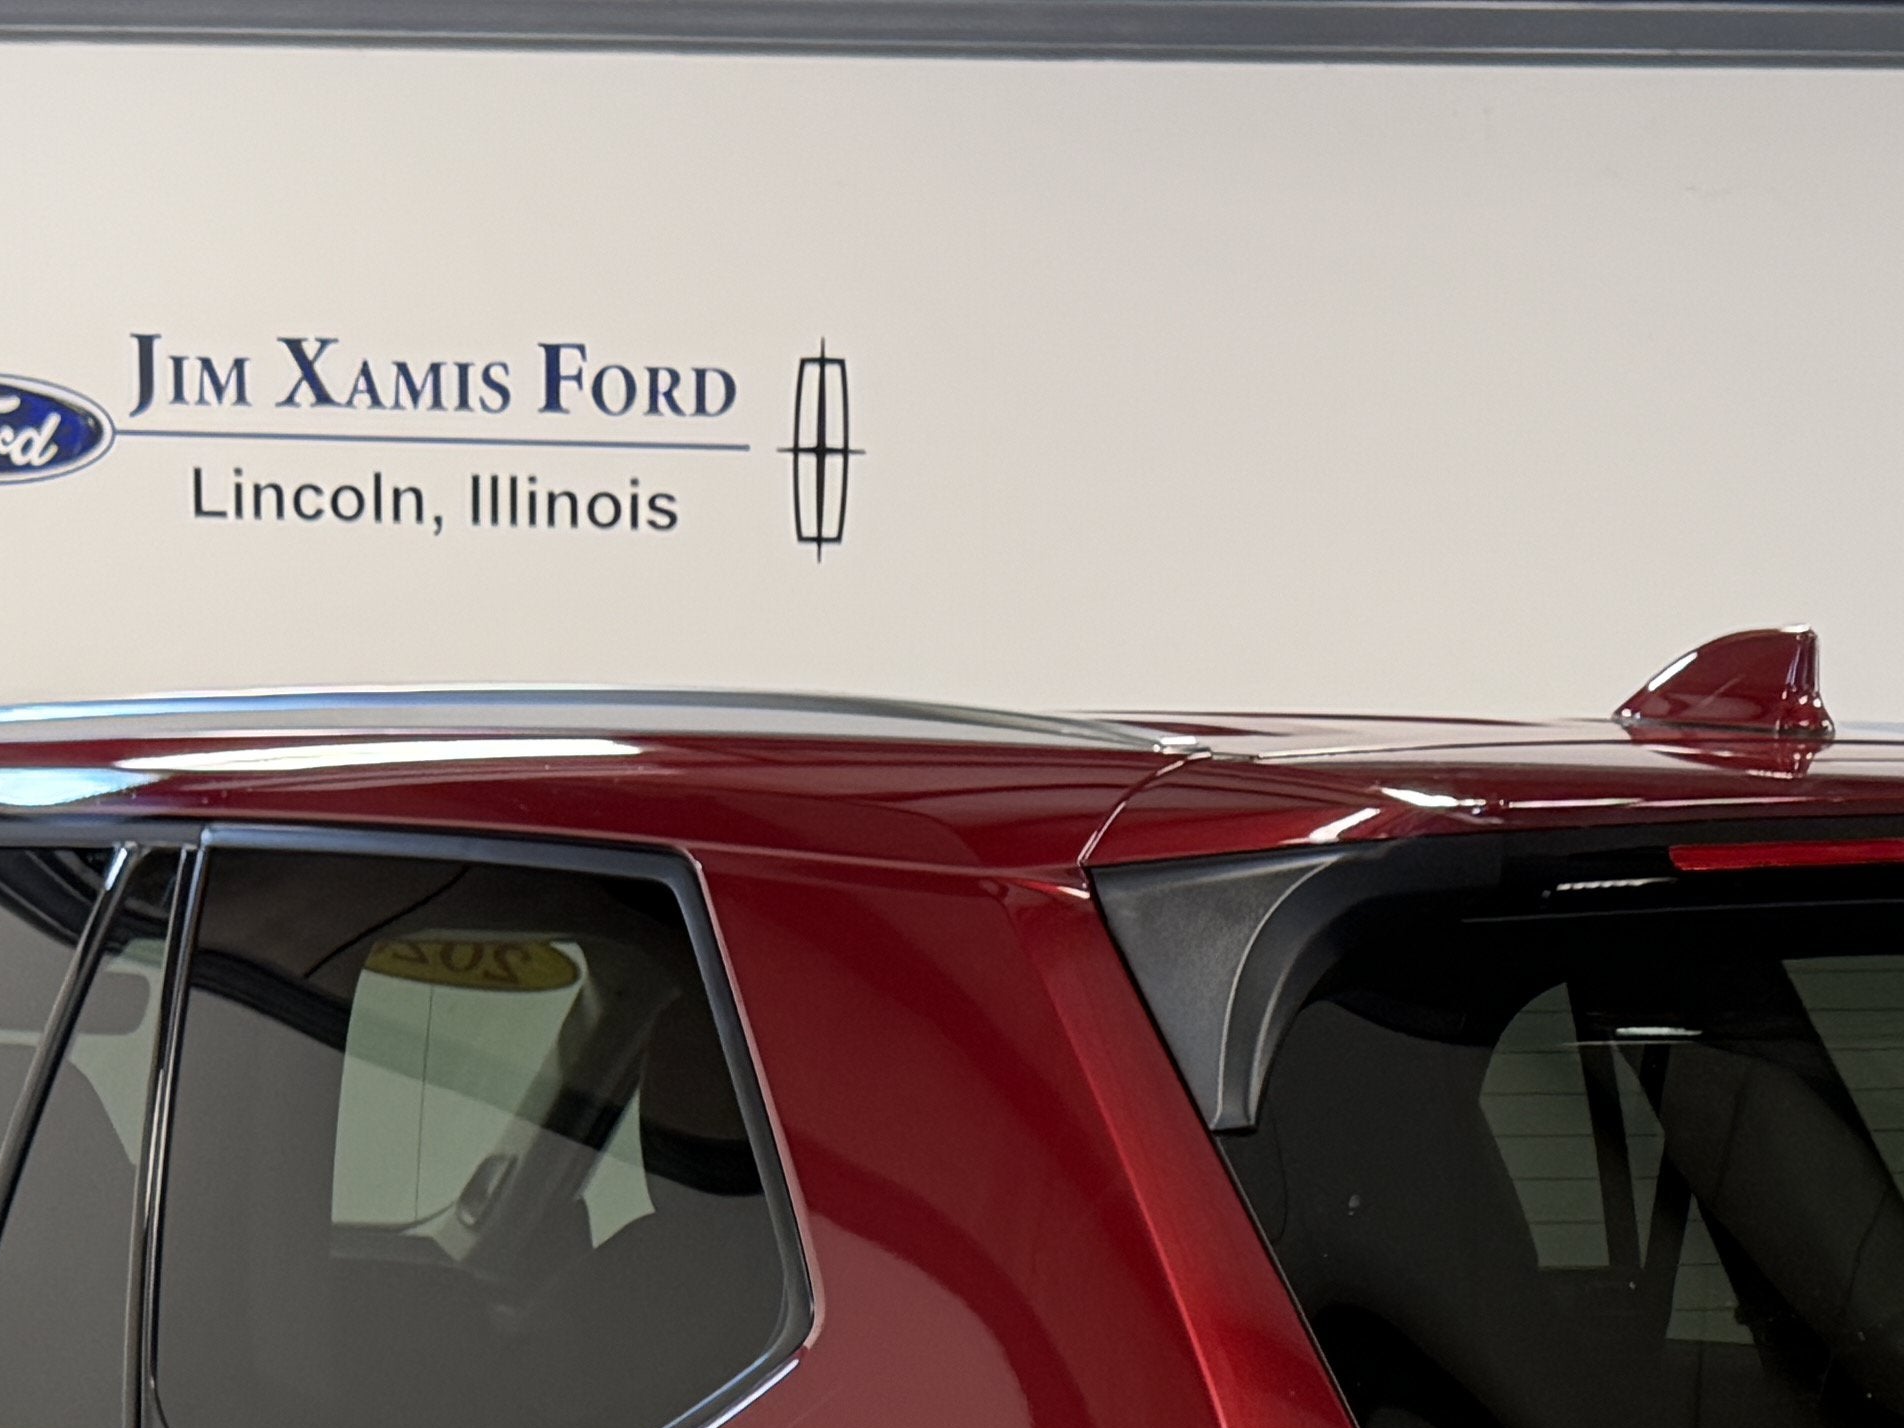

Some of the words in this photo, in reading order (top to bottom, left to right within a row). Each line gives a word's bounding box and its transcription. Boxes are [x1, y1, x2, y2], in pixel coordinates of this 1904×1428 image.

[129, 333, 252, 417] JIM
[275, 337, 512, 414] XAMIS
[537, 342, 737, 417] FORD
[193, 466, 444, 536] Lincoln,
[471, 473, 679, 532] Illinois
